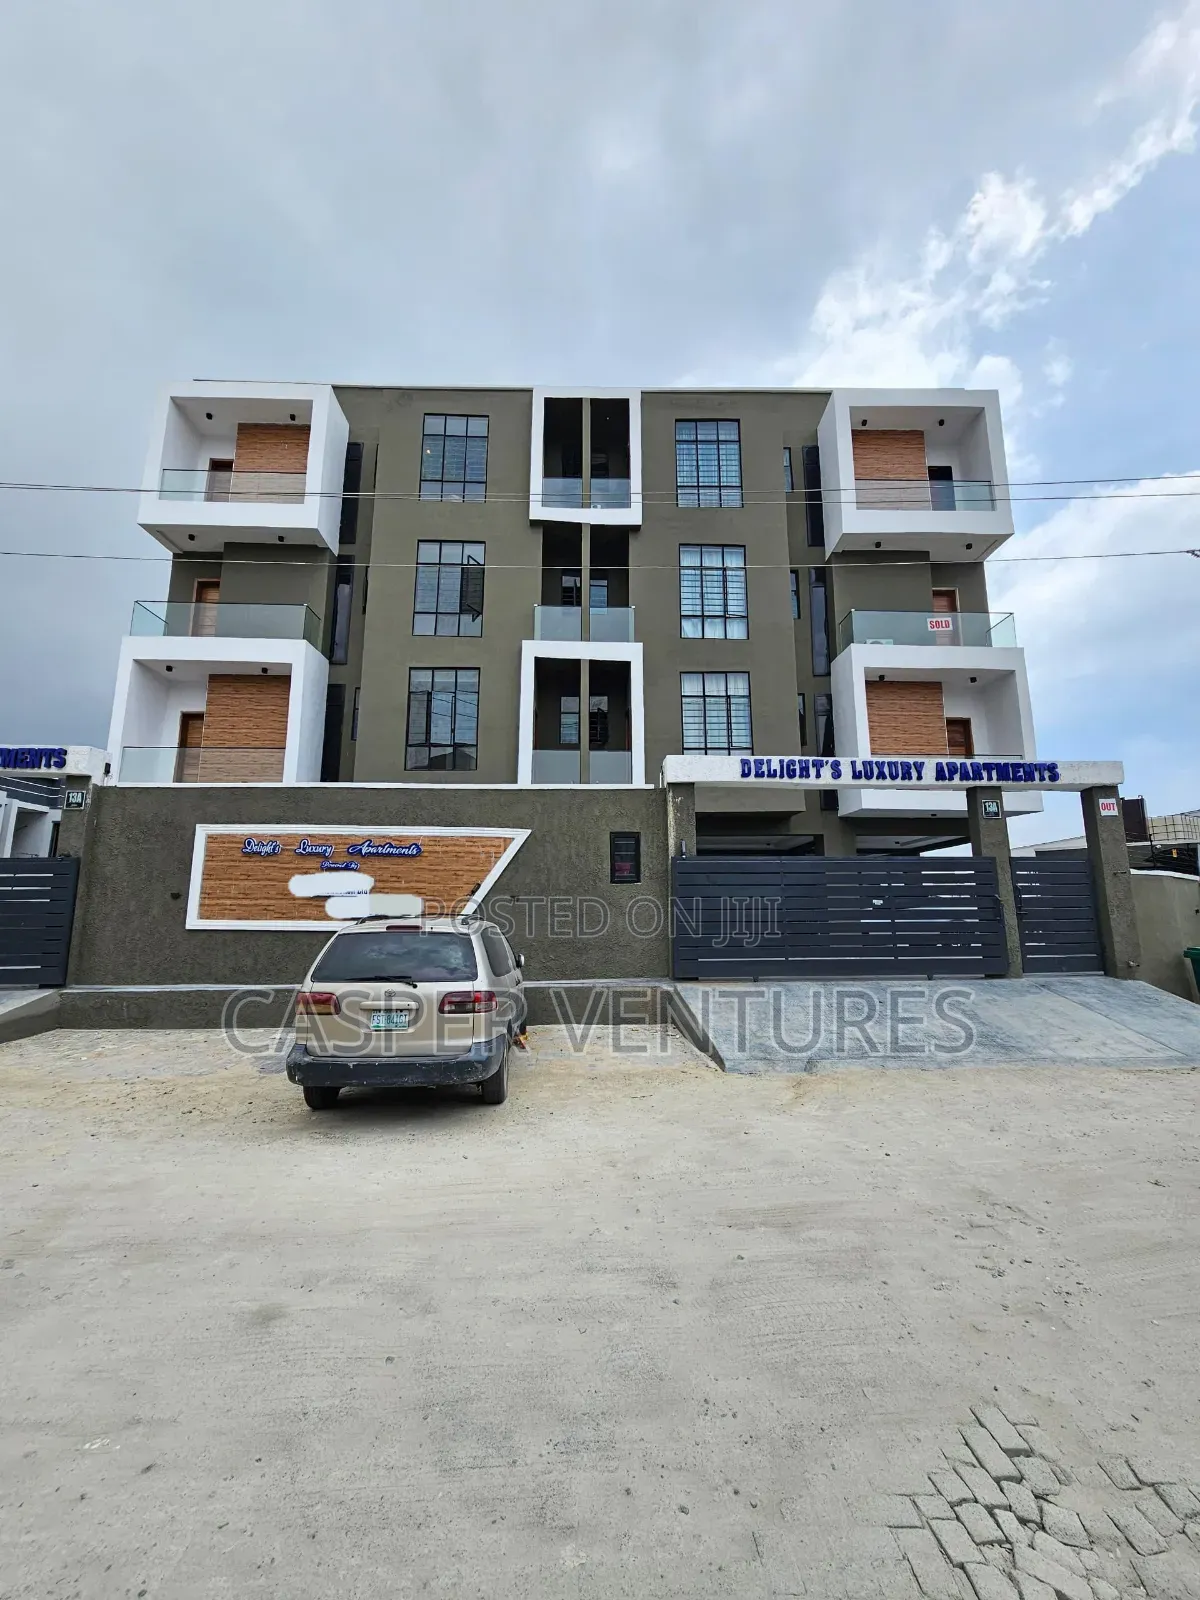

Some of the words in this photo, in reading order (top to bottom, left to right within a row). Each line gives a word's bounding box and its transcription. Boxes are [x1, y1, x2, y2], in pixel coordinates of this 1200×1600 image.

[929, 620, 950, 629] SOLD
[740, 758, 842, 780] DELIGHT'S
[851, 760, 925, 781] LUXURY
[935, 761, 1060, 783] APARTMENTS
[68, 792, 82, 804] 13A
[985, 801, 998, 812] 13A
[1100, 802, 1116, 811] OUT
[242, 838, 281, 857] Delight's
[295, 838, 334, 857] Luxury
[347, 840, 422, 857] Apartments
